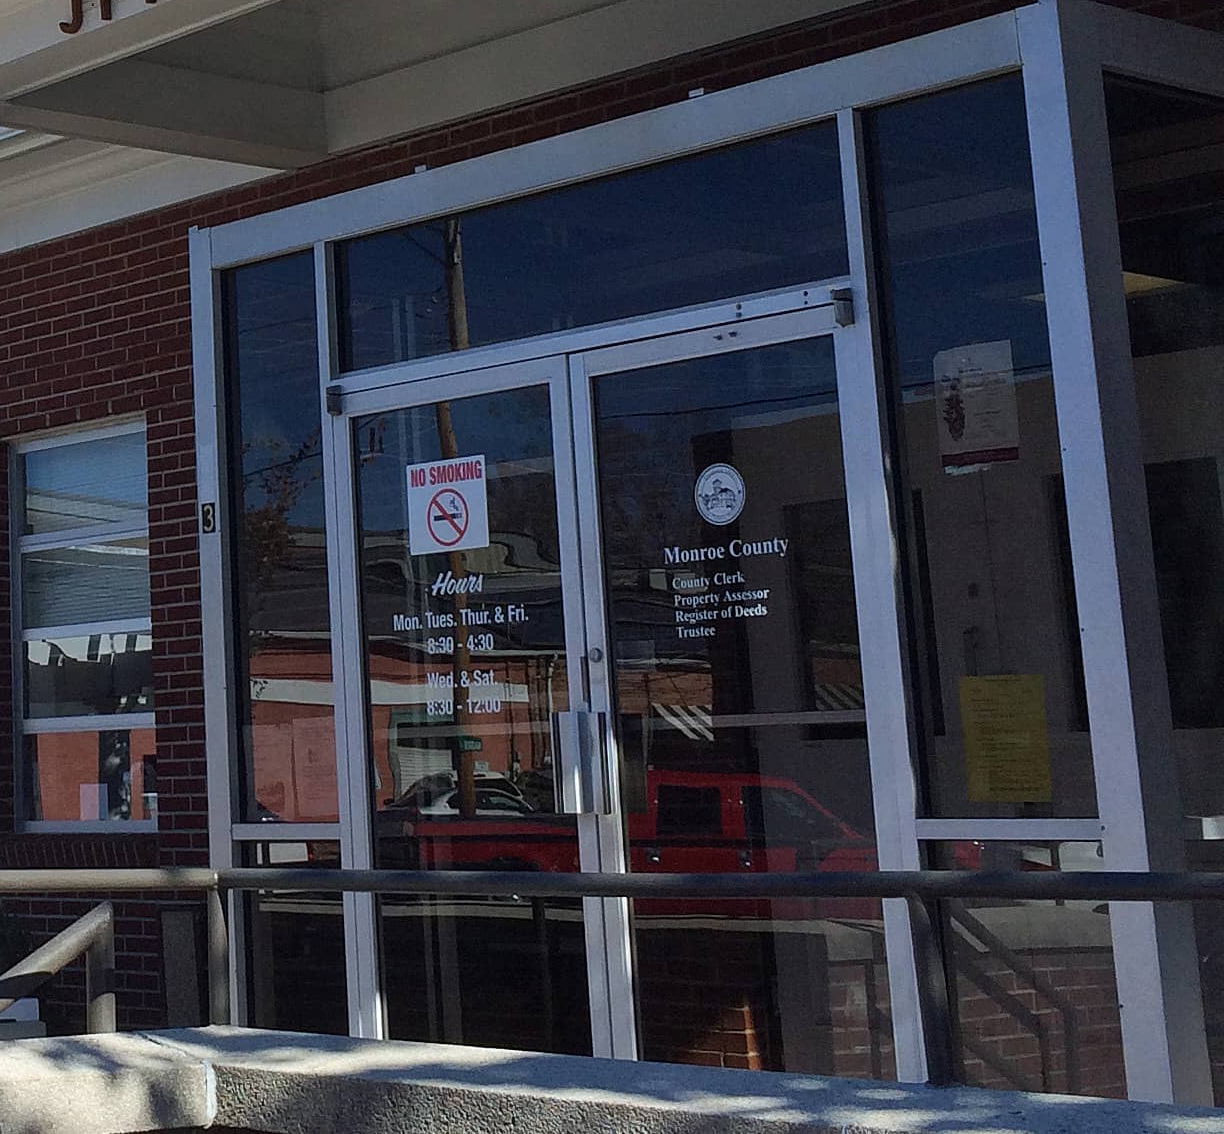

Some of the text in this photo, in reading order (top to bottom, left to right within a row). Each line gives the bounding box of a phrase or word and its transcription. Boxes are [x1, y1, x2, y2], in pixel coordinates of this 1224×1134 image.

[410, 460, 483, 488] NO SMOKING
[203, 504, 214, 532] 3
[664, 537, 789, 565] Monroe County
[431, 570, 484, 596] Hours
[672, 571, 746, 589] County Clerk
[674, 589, 770, 608] Property Assessor
[393, 604, 529, 632] Mon. Tues. Thur. & Fri.
[676, 604, 768, 624] Register of Deeds
[676, 626, 716, 639] Trustee
[427, 636, 454, 655] 8:30
[466, 633, 494, 651] 4:30
[427, 669, 499, 689] Wed. & Sat.
[427, 699, 454, 715] 8:30
[467, 697, 501, 714] 12:00
